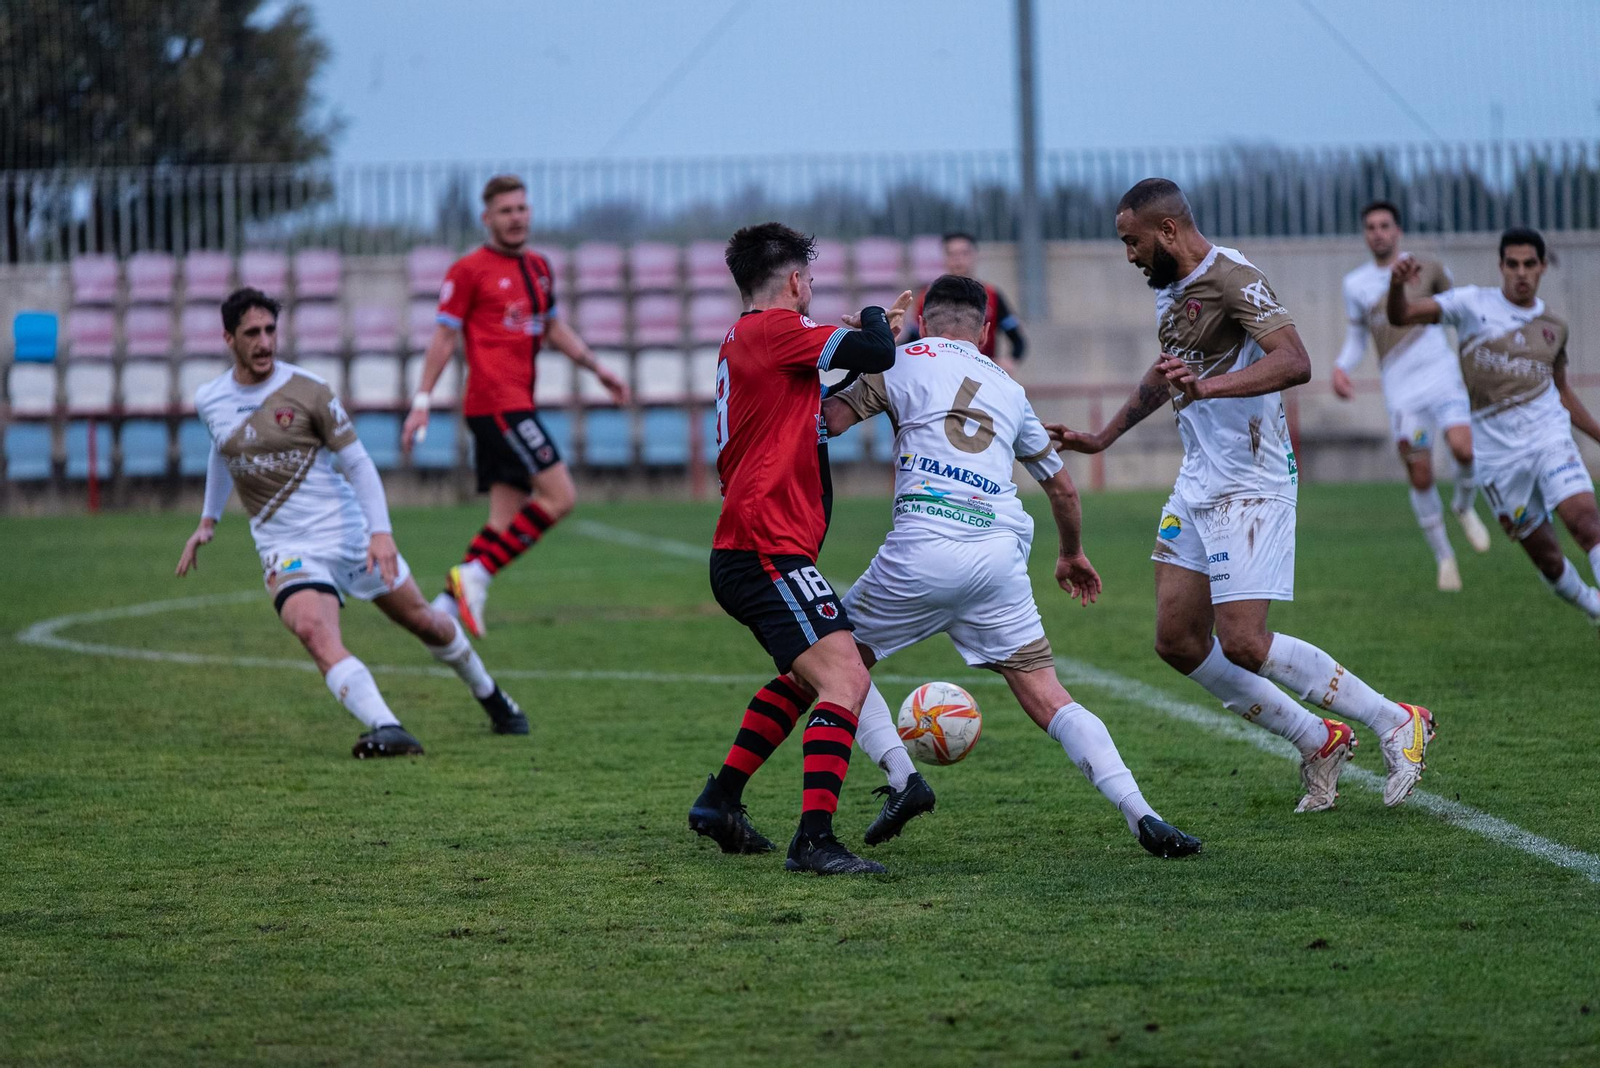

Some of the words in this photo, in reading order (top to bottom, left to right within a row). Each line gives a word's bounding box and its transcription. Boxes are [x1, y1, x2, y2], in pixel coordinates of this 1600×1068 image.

[944, 376, 997, 454] 6
[919, 456, 1001, 495] TAMESUR
[926, 505, 993, 528] GASÓLEOS
[787, 565, 834, 602] 18
